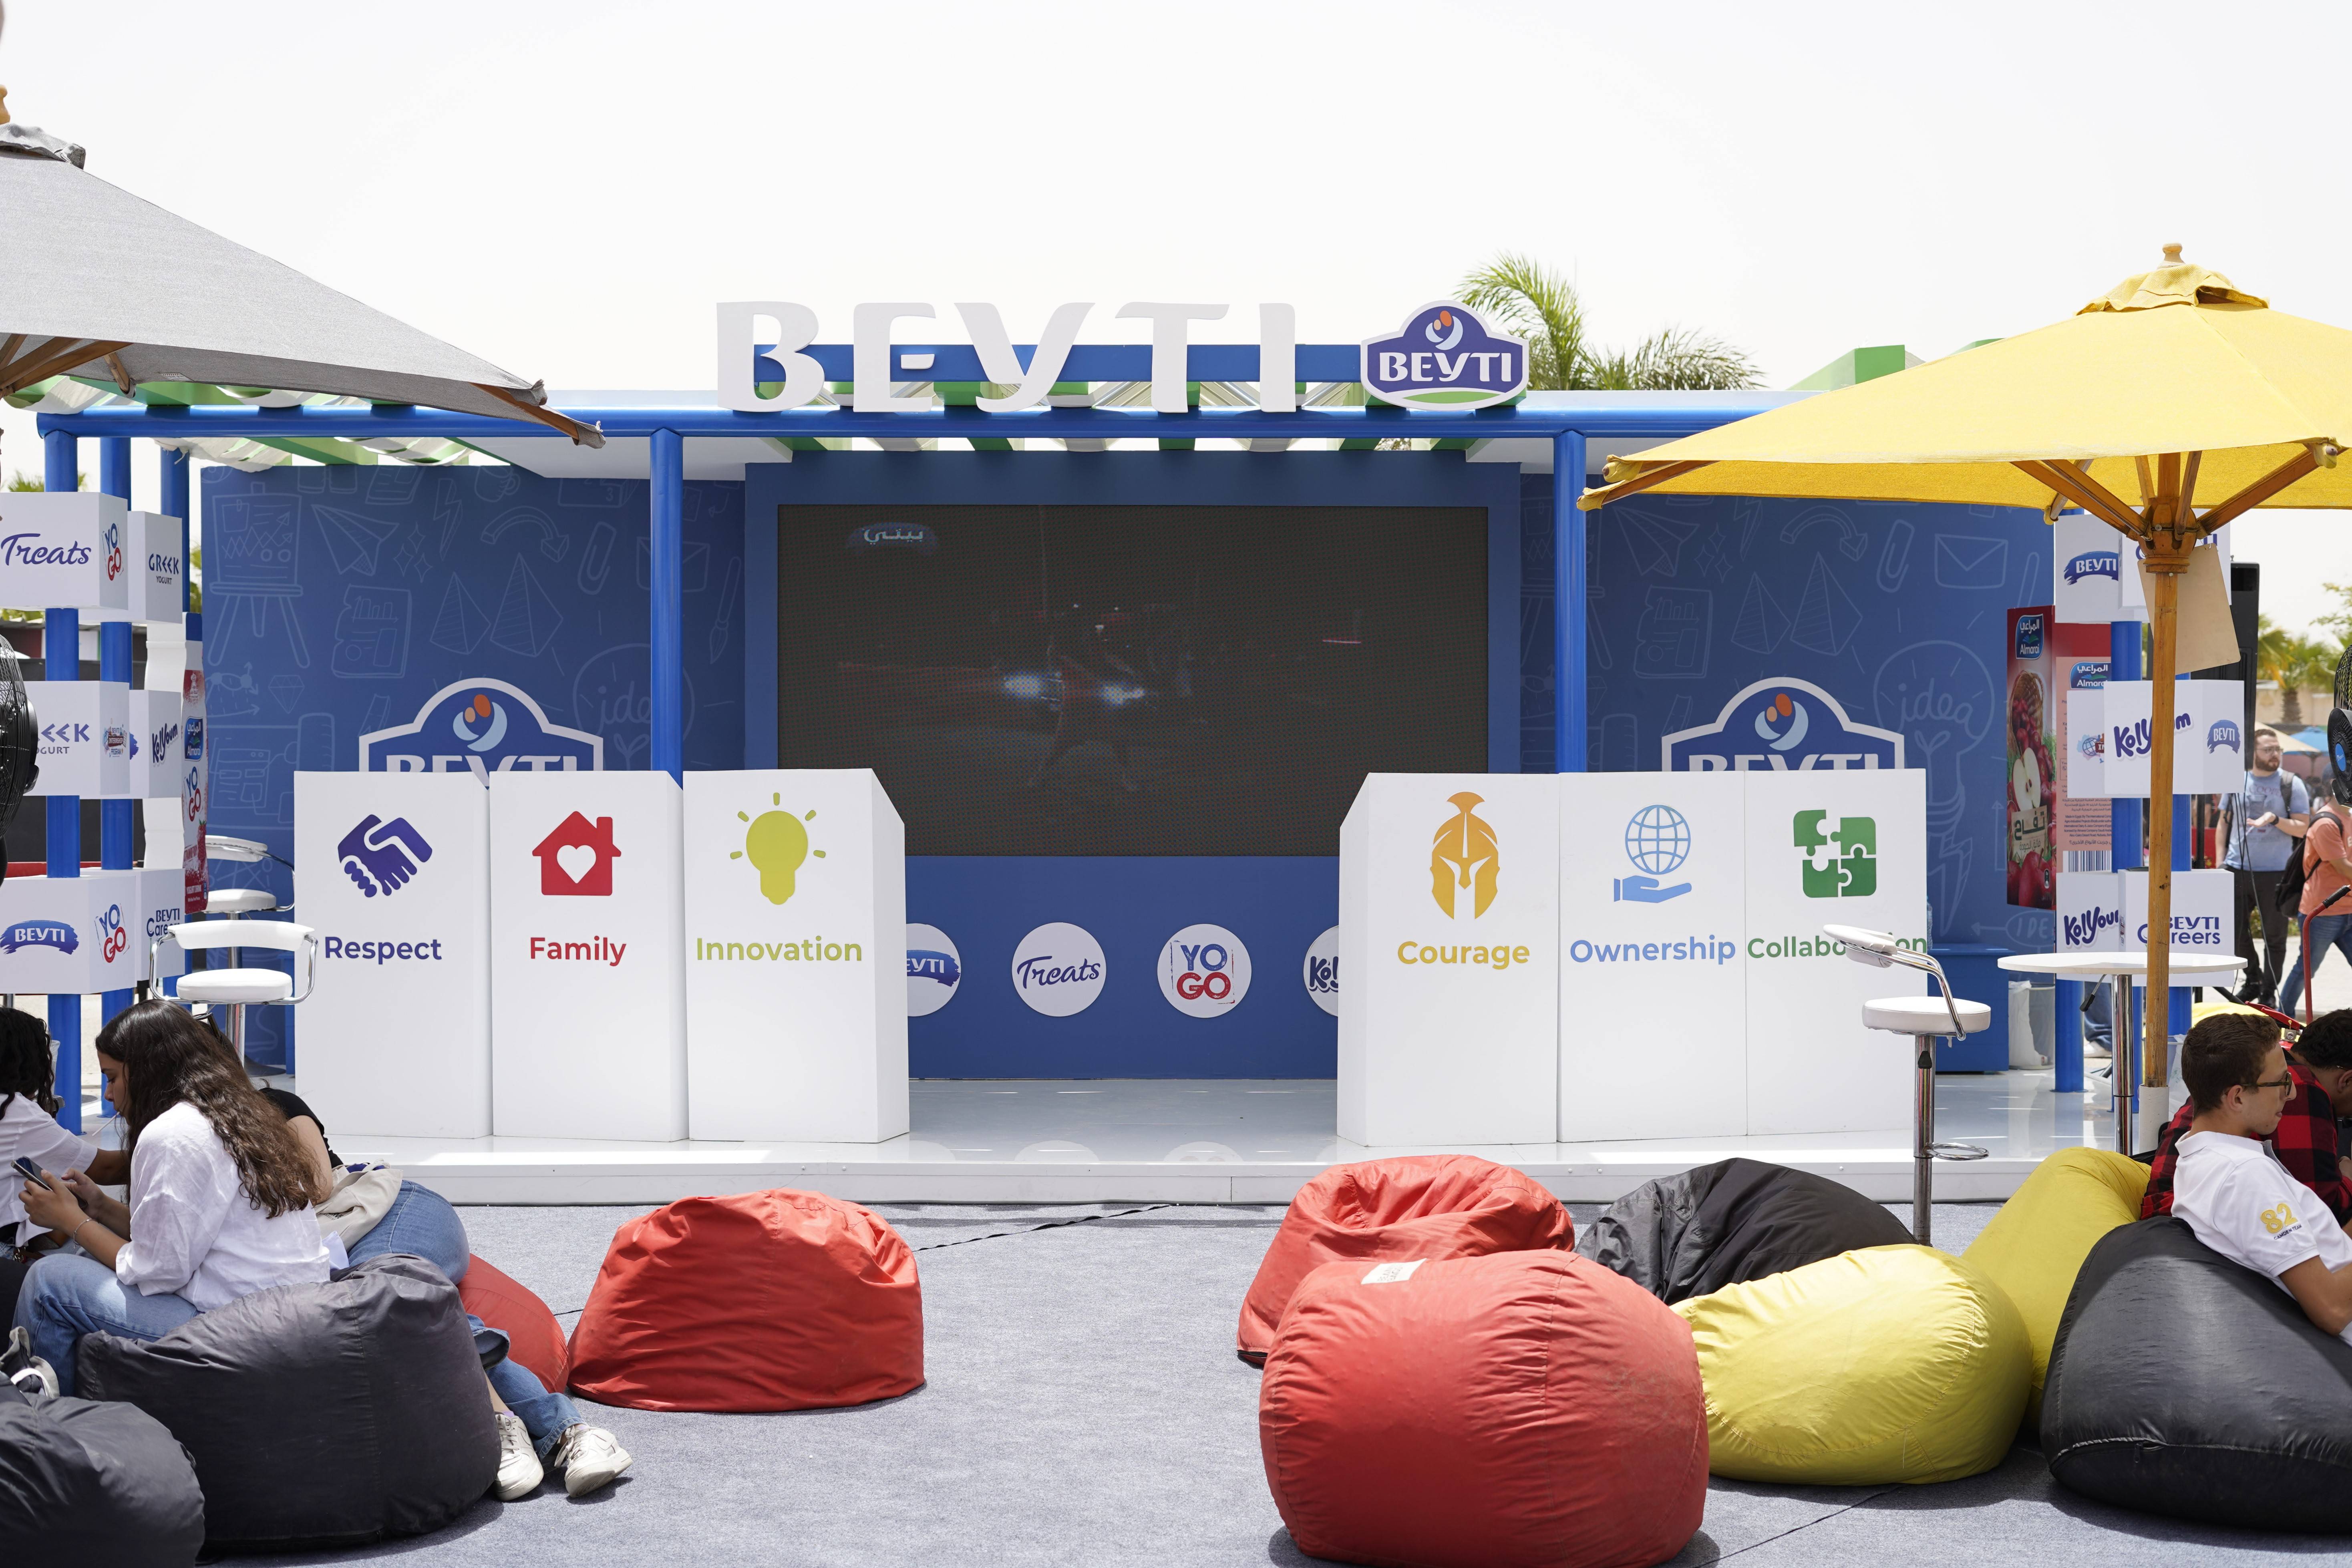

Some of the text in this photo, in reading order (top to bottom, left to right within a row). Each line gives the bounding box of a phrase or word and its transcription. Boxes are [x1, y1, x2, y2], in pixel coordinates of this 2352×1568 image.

[716, 301, 1296, 413] BEYTI
[1379, 352, 1512, 383] BEYTI
[1, 533, 92, 566] Treats
[105, 523, 118, 554] YO
[862, 528, 923, 545] بيتي
[108, 547, 121, 581] GO
[149, 553, 179, 575] GREEK
[2076, 558, 2117, 574] BEYTI
[156, 575, 172, 585] YOGURT
[2020, 619, 2040, 634] المراعي
[2020, 643, 2040, 655] Almarai
[2077, 664, 2108, 674] المراعي
[598, 680, 651, 731] ide
[1897, 677, 1973, 731] idea
[38, 723, 90, 743] EEK
[152, 723, 177, 764] KolYoum
[2113, 713, 2191, 758] KolYm
[2213, 728, 2235, 742] BEYTI
[36, 746, 70, 754] GURT
[187, 746, 201, 756] Almarai
[186, 766, 198, 797] YO
[189, 788, 201, 822] GO
[2014, 811, 2045, 841] تفاح
[99, 903, 121, 933] YO
[147, 917, 180, 937] Care
[156, 908, 180, 922] BEYTI
[2016, 917, 2051, 939] IDE
[15, 927, 65, 943] BEYTI
[103, 927, 126, 963] GO
[1747, 932, 1927, 959] Collaboon
[2137, 923, 2221, 945] Creers
[325, 936, 443, 964] Respect
[529, 936, 627, 967] Family
[697, 936, 862, 962] Innovation
[1180, 943, 1226, 971] YO
[1397, 941, 1530, 970] Courage
[1570, 935, 1736, 965] Ownership
[907, 958, 944, 973] YTI
[1016, 956, 1101, 989] Treats
[1176, 971, 1231, 1000] GO
[2261, 1203, 2298, 1234] 82
[2274, 1228, 2293, 1240] CAMDEN
